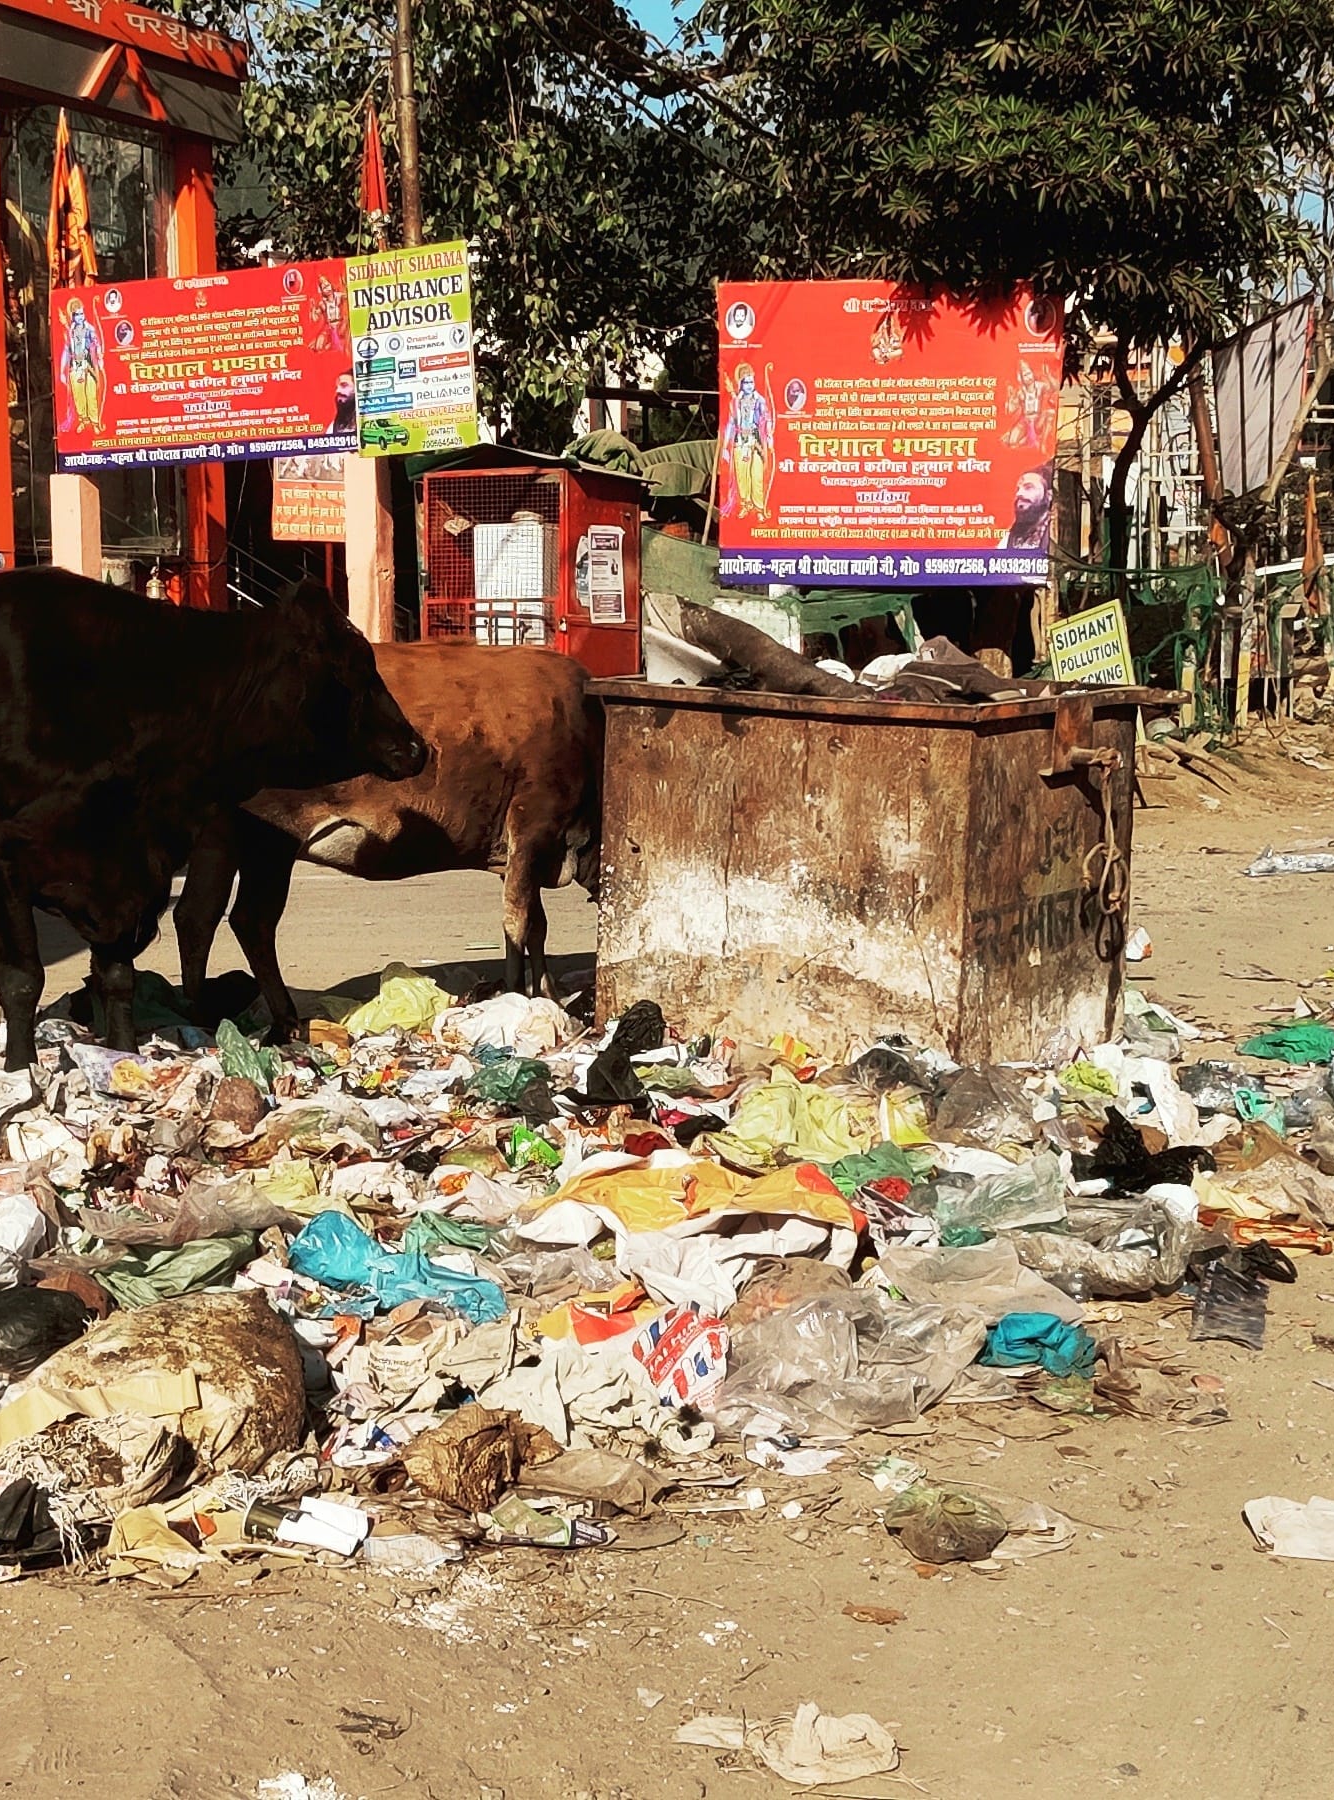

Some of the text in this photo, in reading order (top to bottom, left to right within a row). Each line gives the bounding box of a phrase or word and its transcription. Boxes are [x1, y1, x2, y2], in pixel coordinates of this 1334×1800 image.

[348, 249, 464, 281] SIDHANT SHARMA
[353, 274, 463, 308] INSURANCE
[367, 302, 452, 331] ADVISOR
[130, 353, 288, 381] विशाल भण्डारा
[798, 434, 978, 457] विशाल भण्डारा
[779, 459, 794, 472] श्री
[912, 461, 953, 476] हनुमान
[989, 558, 1049, 574] 8493829166
[1055, 614, 1114, 650] SIDHANT
[1061, 640, 1120, 674] POLLUTION
[1080, 664, 1123, 684] CKING
